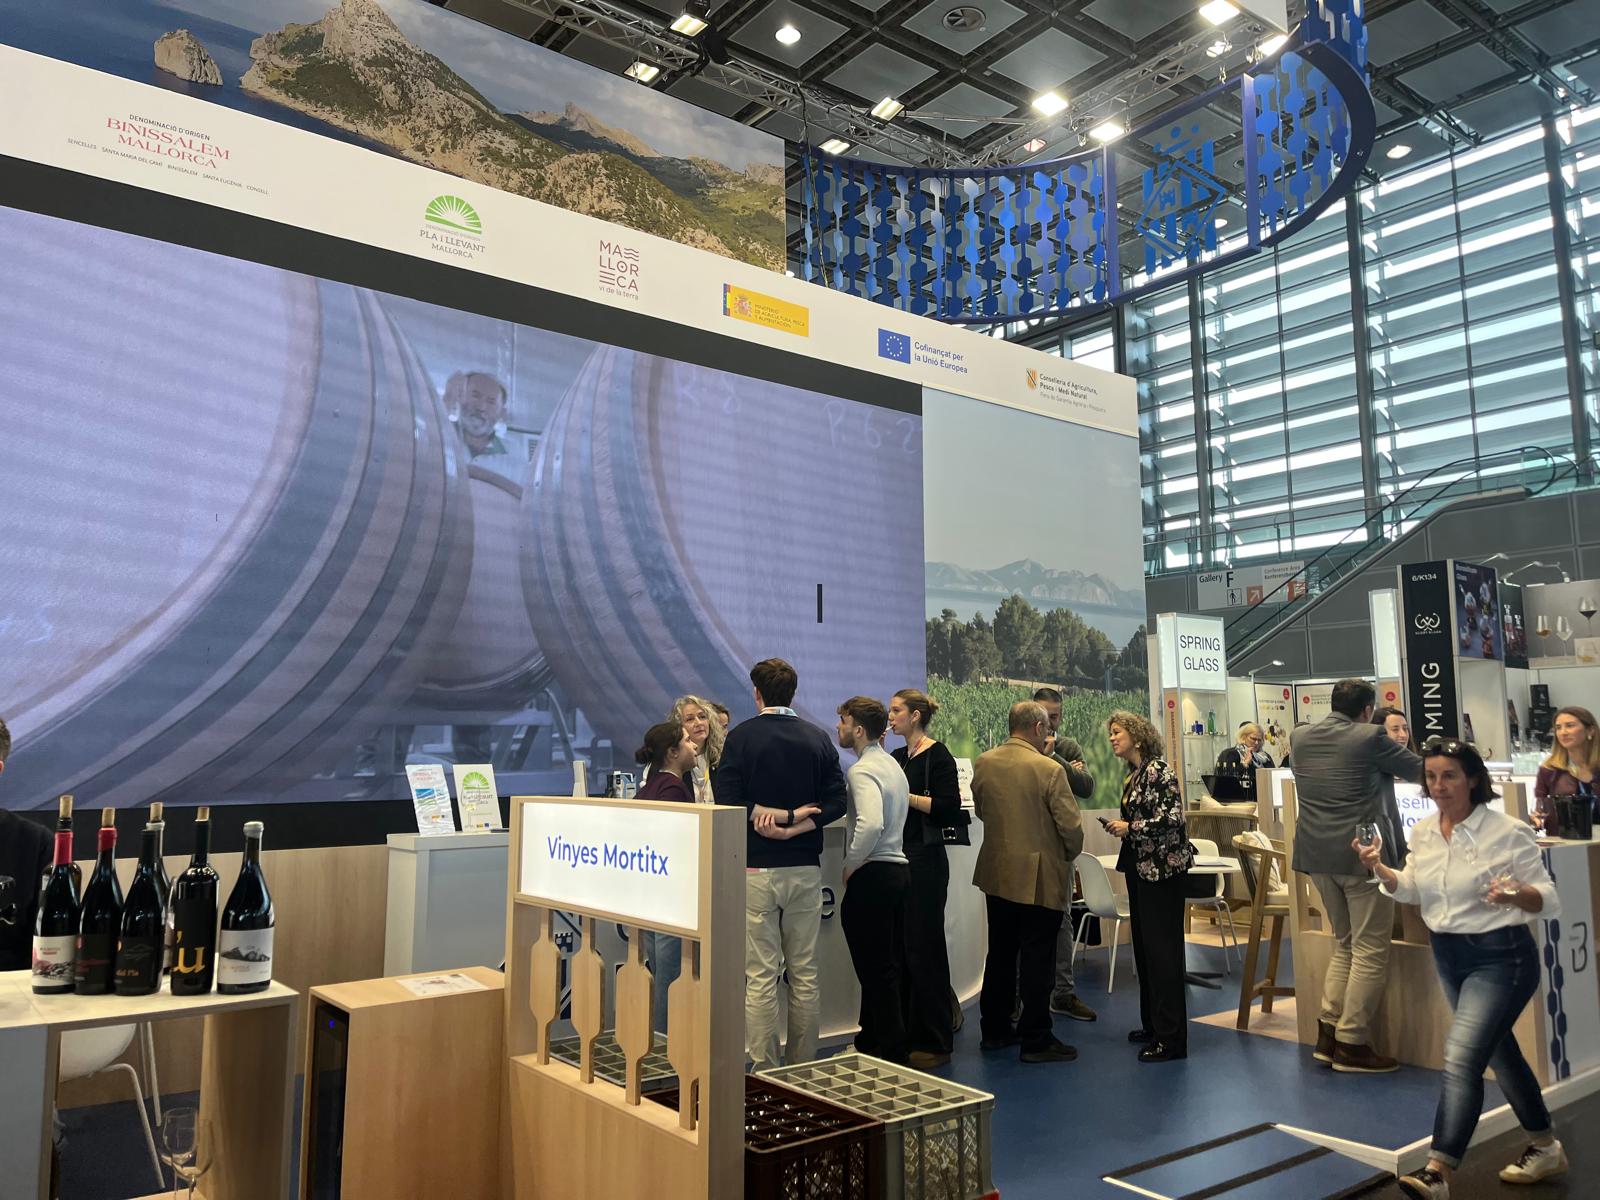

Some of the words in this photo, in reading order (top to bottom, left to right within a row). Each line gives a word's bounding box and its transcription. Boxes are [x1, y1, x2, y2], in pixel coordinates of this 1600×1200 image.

[130, 114, 177, 131] DENOMINACIÓ
[179, 128, 210, 141] D'ORIGEN
[106, 118, 230, 160] BINISSALEM
[102, 146, 119, 156] SANTA
[119, 134, 217, 168] MALLORCA
[420, 229, 438, 241] PLA
[446, 236, 485, 253] LLEVANT
[600, 240, 623, 258] MA
[432, 243, 473, 258] MALLORCA
[600, 255, 639, 277] LLOR
[617, 276, 638, 292] CA
[623, 291, 639, 300] terra
[914, 341, 951, 358] Cofinançat
[952, 353, 964, 361] per
[915, 353, 920, 361] la
[922, 355, 938, 366] Unió
[940, 360, 968, 373] Europea
[1040, 373, 1066, 386] Conselleria
[1040, 382, 1054, 391] Pesca
[1058, 386, 1069, 395] Medi
[1070, 390, 1087, 400] Natural
[1200, 574, 1223, 584] Gallery
[1226, 571, 1234, 588] F
[1180, 635, 1220, 651] SPRING
[1183, 656, 1219, 671] GLASS
[548, 835, 598, 868] Vinyes
[604, 843, 669, 876] Mortitx
